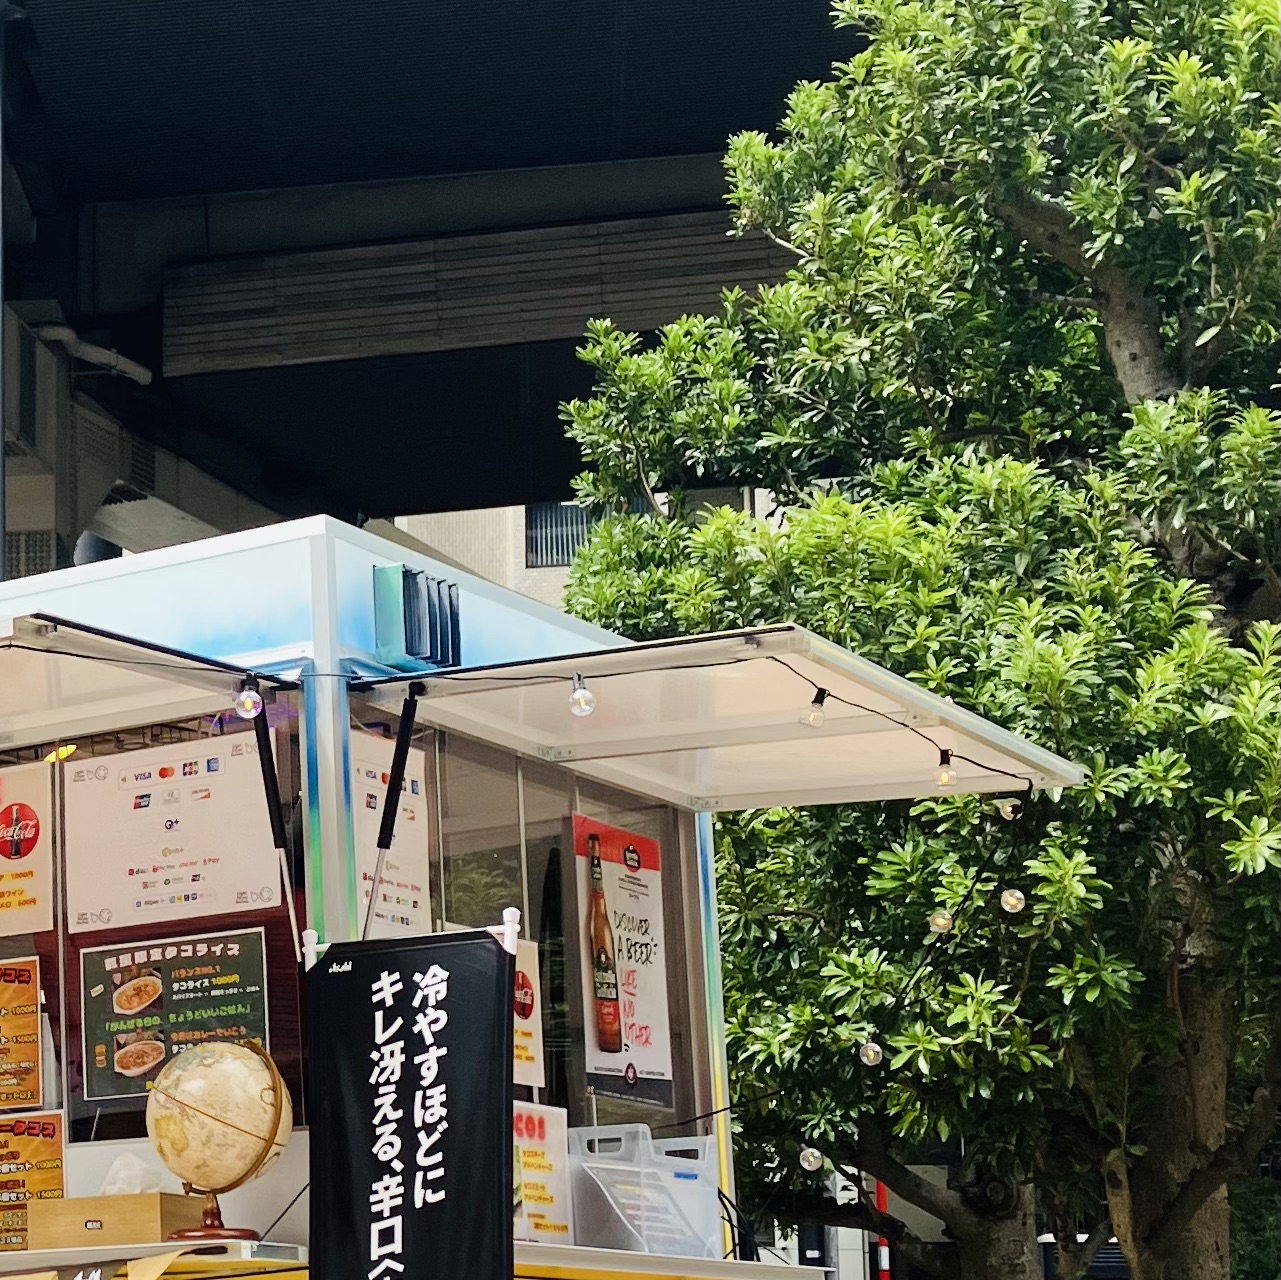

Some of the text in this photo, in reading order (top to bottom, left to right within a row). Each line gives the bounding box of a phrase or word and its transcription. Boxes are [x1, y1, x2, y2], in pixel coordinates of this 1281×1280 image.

[625, 938, 653, 965] BEER
[411, 964, 450, 1209] 冷やすほどに
